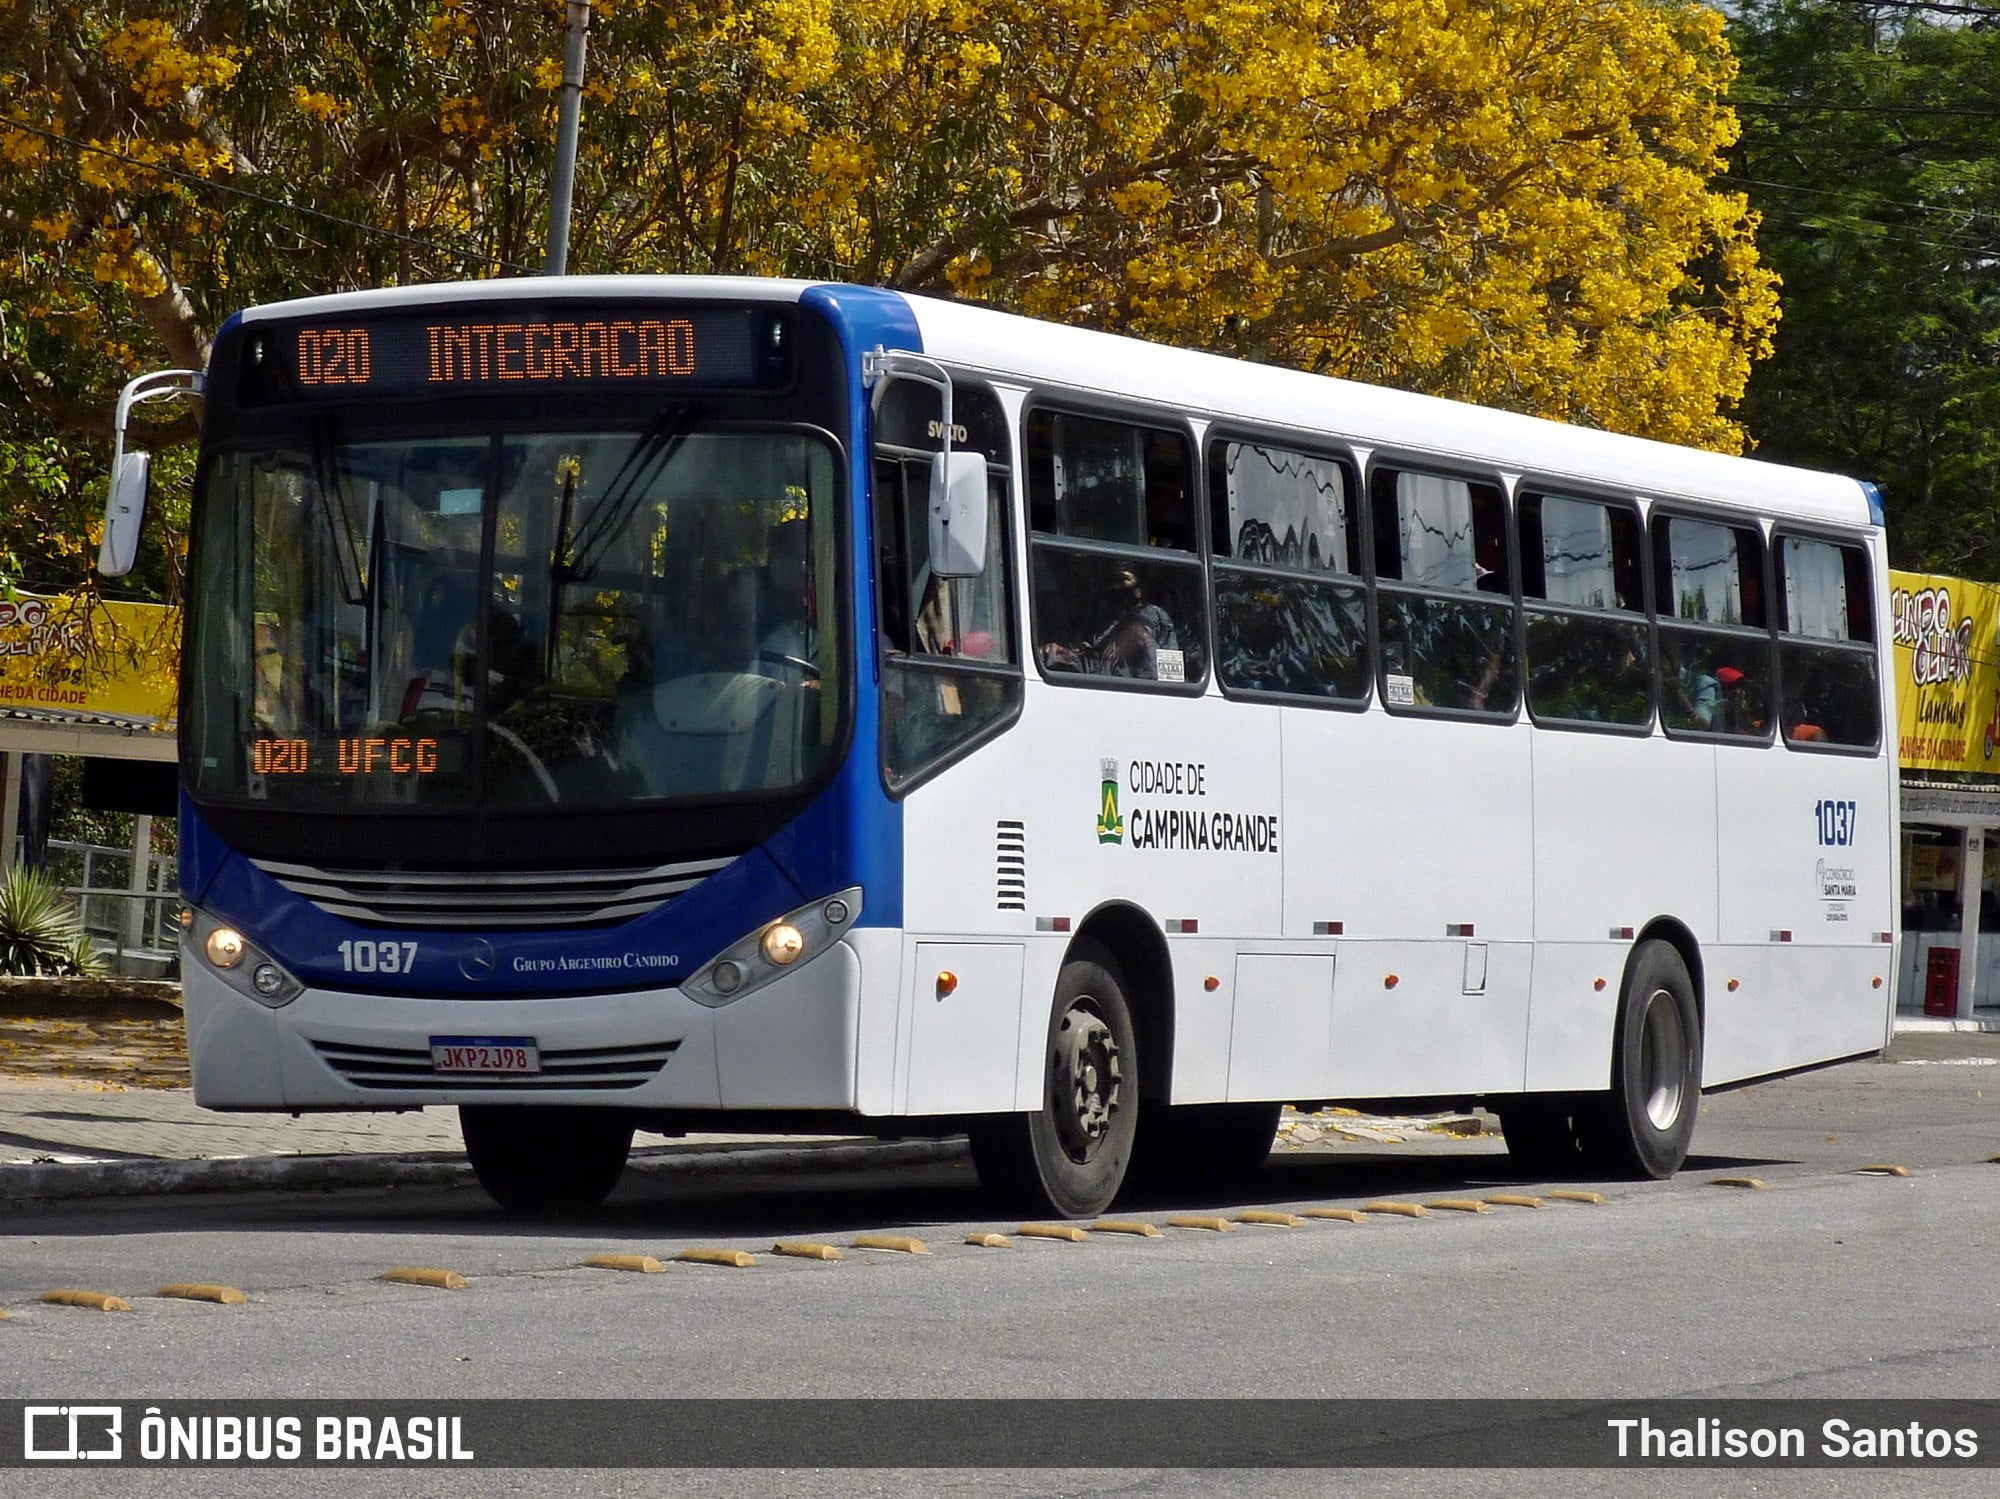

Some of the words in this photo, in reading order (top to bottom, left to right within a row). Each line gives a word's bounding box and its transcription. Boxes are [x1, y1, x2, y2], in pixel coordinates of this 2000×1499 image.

[298, 328, 371, 385] 020
[426, 318, 696, 383] INTEGRACAO
[928, 420, 968, 443] SVTO
[16, 686, 34, 700] DA
[38, 687, 87, 704] CIDADE
[1918, 690, 1966, 730] Lanches
[254, 738, 308, 773] 020
[338, 738, 438, 773] UFCG
[1129, 760, 1183, 795] CIDADE
[1187, 764, 1206, 796] DE
[1130, 808, 1209, 850] CAMPINA
[1211, 812, 1278, 853] GRANDE
[1815, 799, 1856, 846] 1037
[337, 940, 418, 974] 1037
[513, 956, 555, 972] GRUPO
[558, 955, 622, 970] ARGEMIRO
[442, 1047, 527, 1069] JKP2J98
